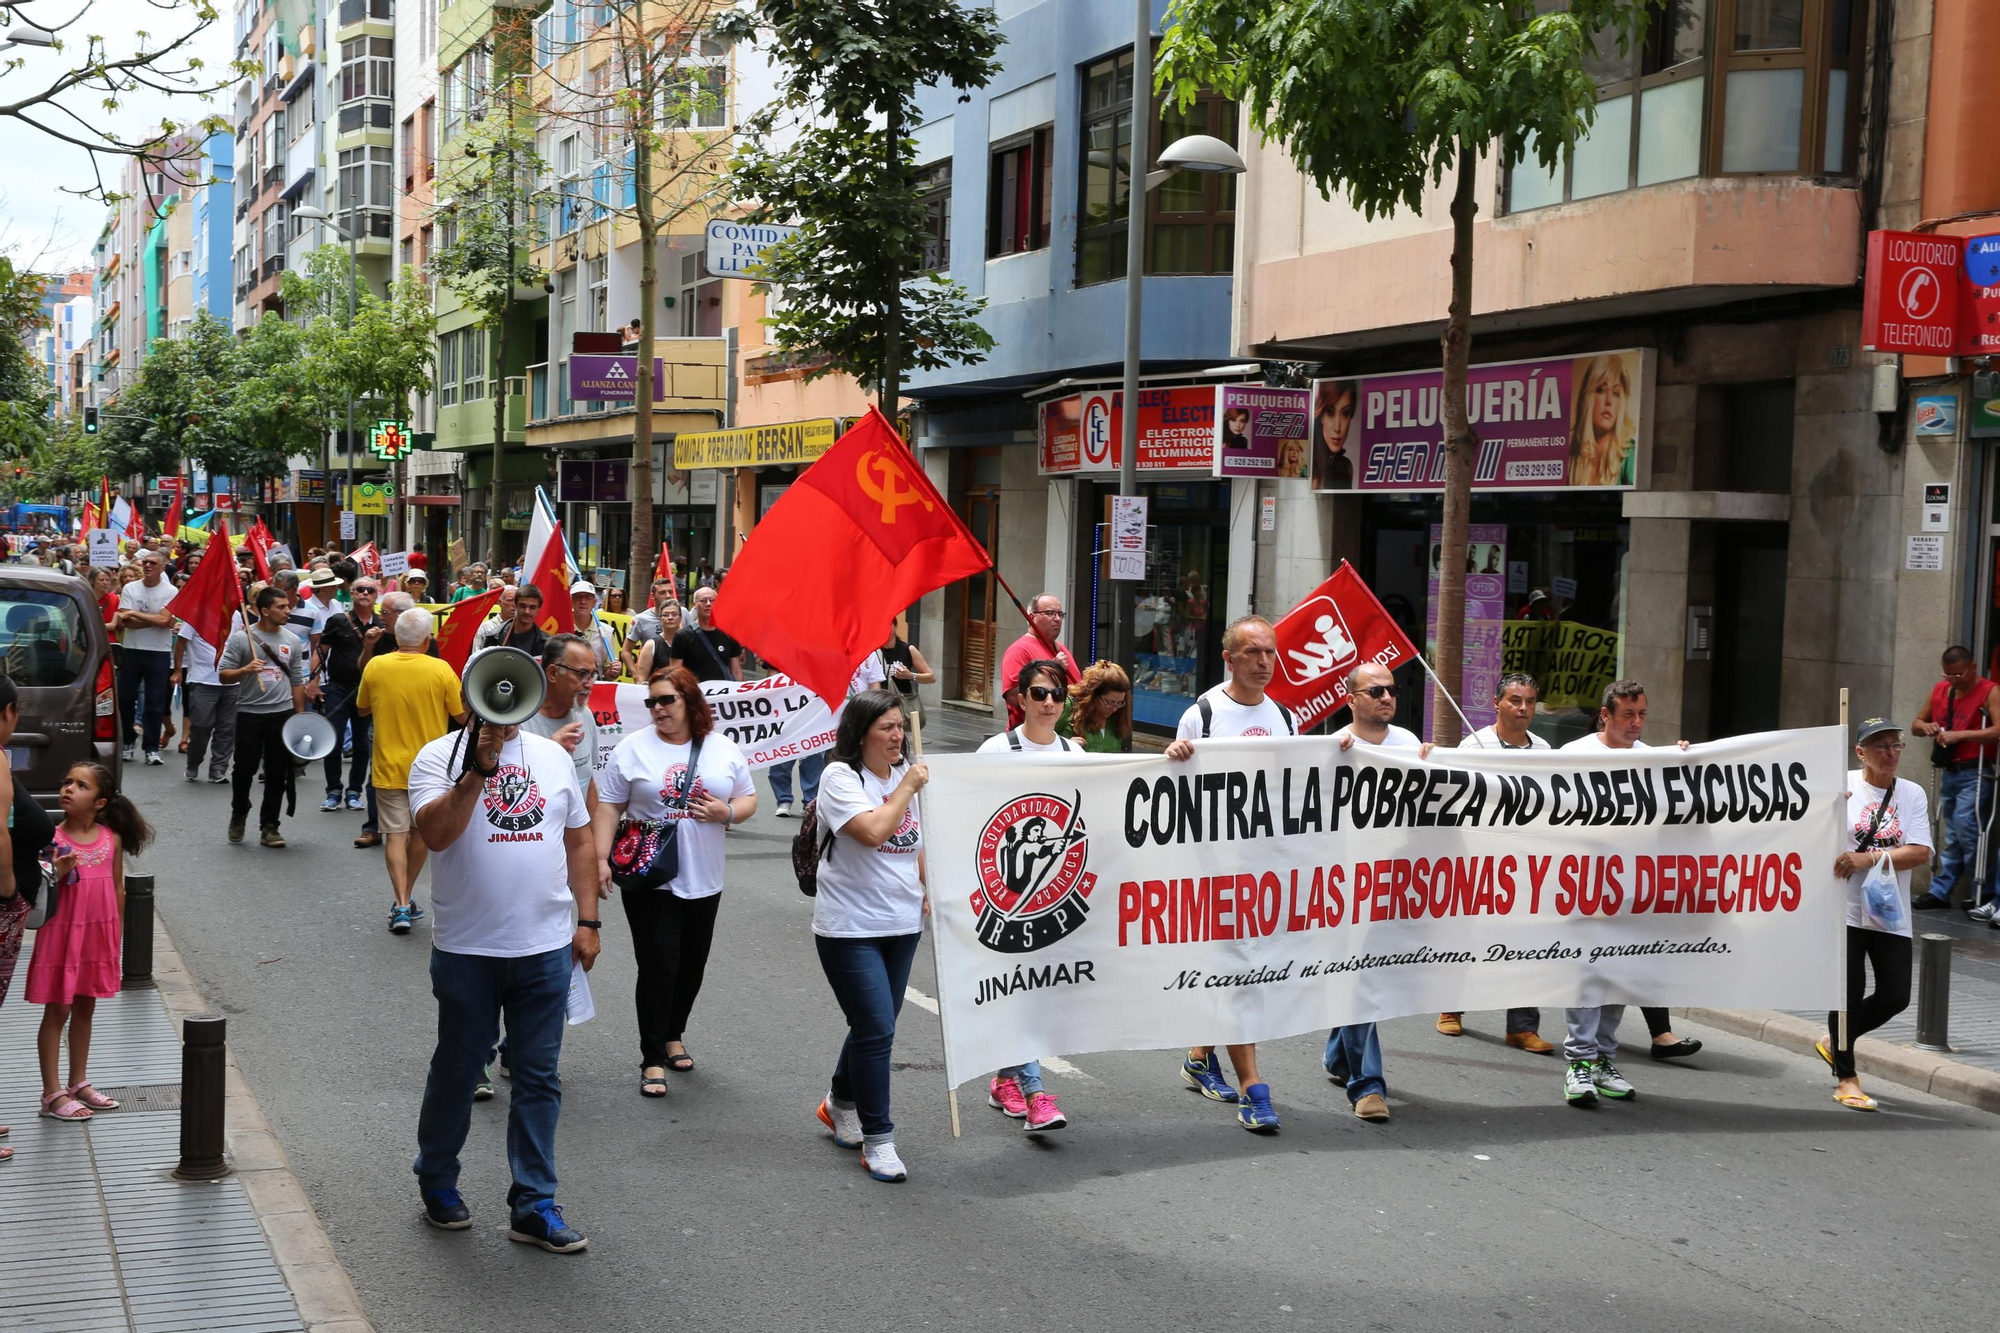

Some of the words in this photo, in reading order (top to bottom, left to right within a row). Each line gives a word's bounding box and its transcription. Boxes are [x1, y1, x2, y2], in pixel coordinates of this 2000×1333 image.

[1888, 239, 1957, 266] LOCUTORIO
[1883, 322, 1952, 348] TELEFONICO
[581, 380, 616, 388] ALIANZA
[1227, 393, 1306, 410] PELUQUERÍA
[1366, 368, 1562, 430] PELUUERÍA
[1255, 411, 1306, 425] SHEN
[675, 437, 705, 464] COMIDAS
[707, 432, 753, 465] PREPARADAS
[757, 425, 803, 461] BERSAN
[1506, 437, 1549, 448] PERMANENTE
[1550, 436, 1566, 446] LISO
[1234, 458, 1246, 466] 928
[1247, 458, 1259, 467] 292
[1260, 459, 1272, 467] 985
[1363, 440, 1430, 483] SHEN
[1515, 464, 1530, 477] 928
[1531, 464, 1546, 477] 292
[1546, 463, 1562, 476] 985
[705, 687, 729, 697] LA
[722, 721, 785, 744] OTAN
[754, 743, 800, 764] CLASE
[1124, 770, 1274, 849] CONTRA
[1282, 766, 1323, 836] LA
[1331, 765, 1488, 832] POBREZA
[1488, 774, 1545, 827] NO
[1549, 768, 1658, 827] CABEN
[1662, 761, 1811, 826] EXCUSAS
[488, 831, 544, 843] JINÁMAR
[983, 800, 1061, 850] SOLIDARIDAD
[1035, 851, 1080, 906] POPULAR
[1118, 870, 1282, 947] PRIMERO
[1286, 864, 1346, 933] LAS
[1351, 854, 1518, 926] PERSONAS
[1527, 855, 1552, 915] Y
[1555, 853, 1624, 917] SUS
[1630, 851, 1803, 915] DERECHOS
[1163, 969, 1198, 991] Ni
[1205, 960, 1295, 989] caridad
[1300, 960, 1322, 980] ni
[1482, 940, 1583, 963] Derechos
[1588, 936, 1733, 964] garantizados.
[974, 960, 1096, 1006] JINÁMAR
